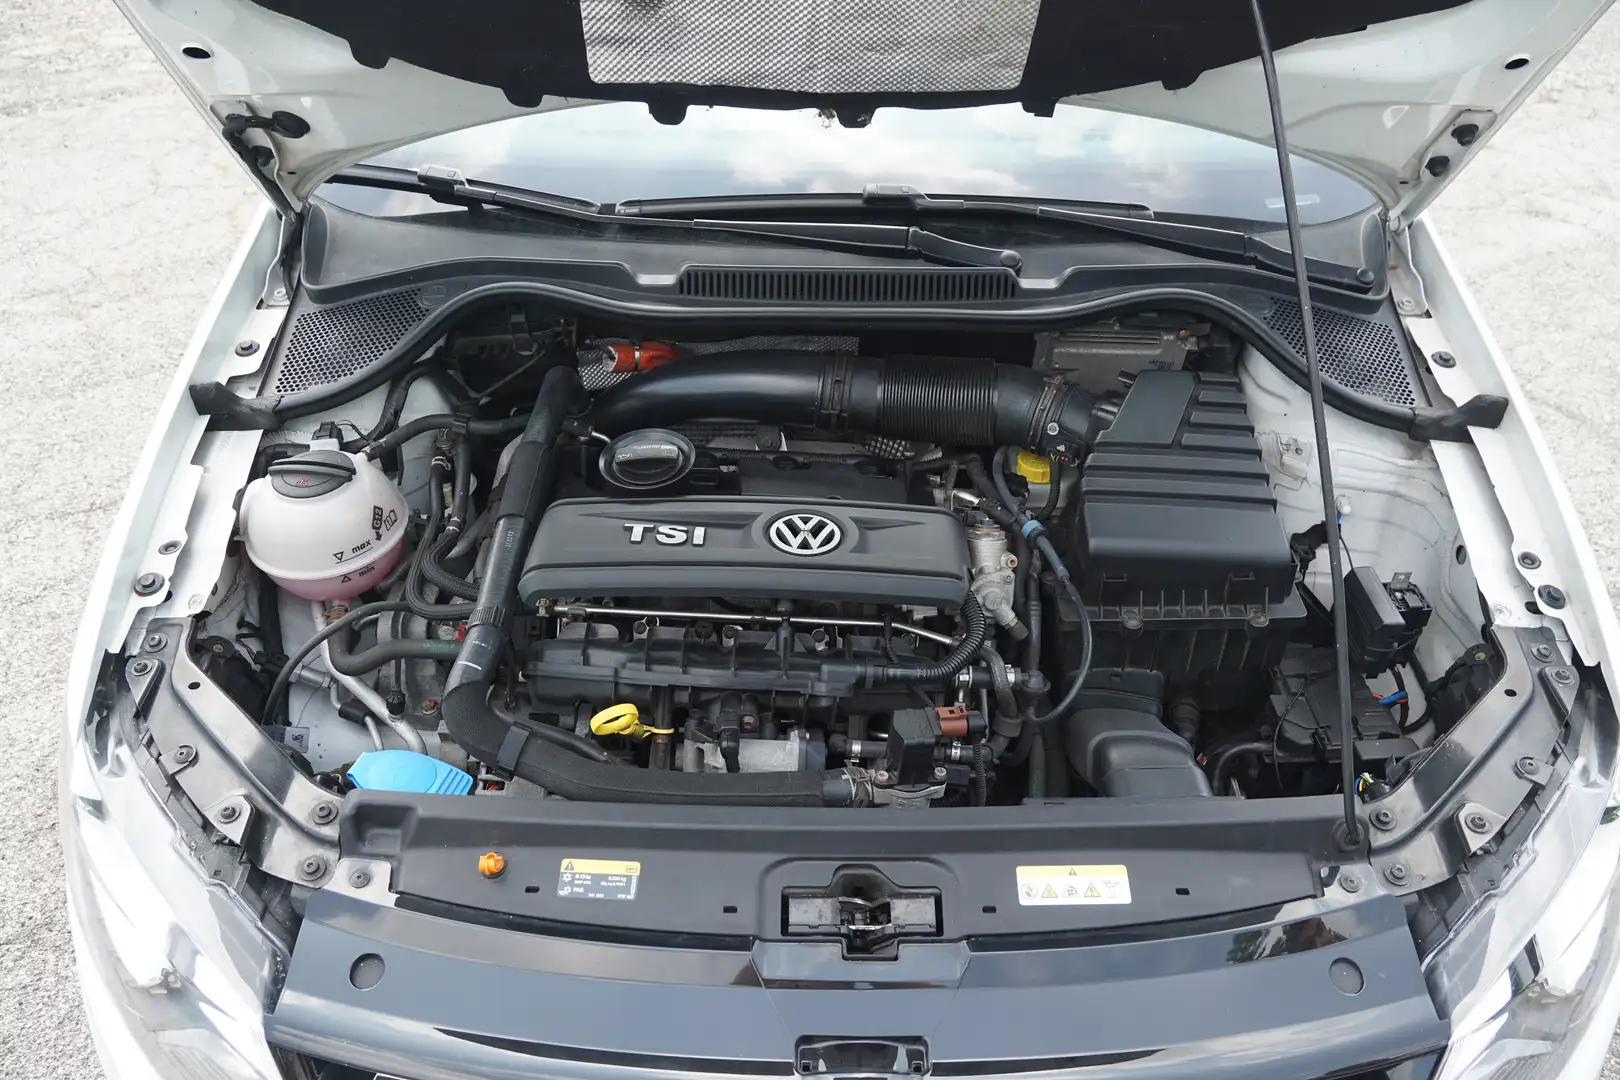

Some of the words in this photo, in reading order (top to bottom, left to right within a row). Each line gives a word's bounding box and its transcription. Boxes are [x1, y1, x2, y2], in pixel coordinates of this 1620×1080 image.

[374, 508, 382, 528] G12
[623, 523, 706, 546] TSI
[352, 540, 371, 553] max
[358, 566, 375, 576] min
